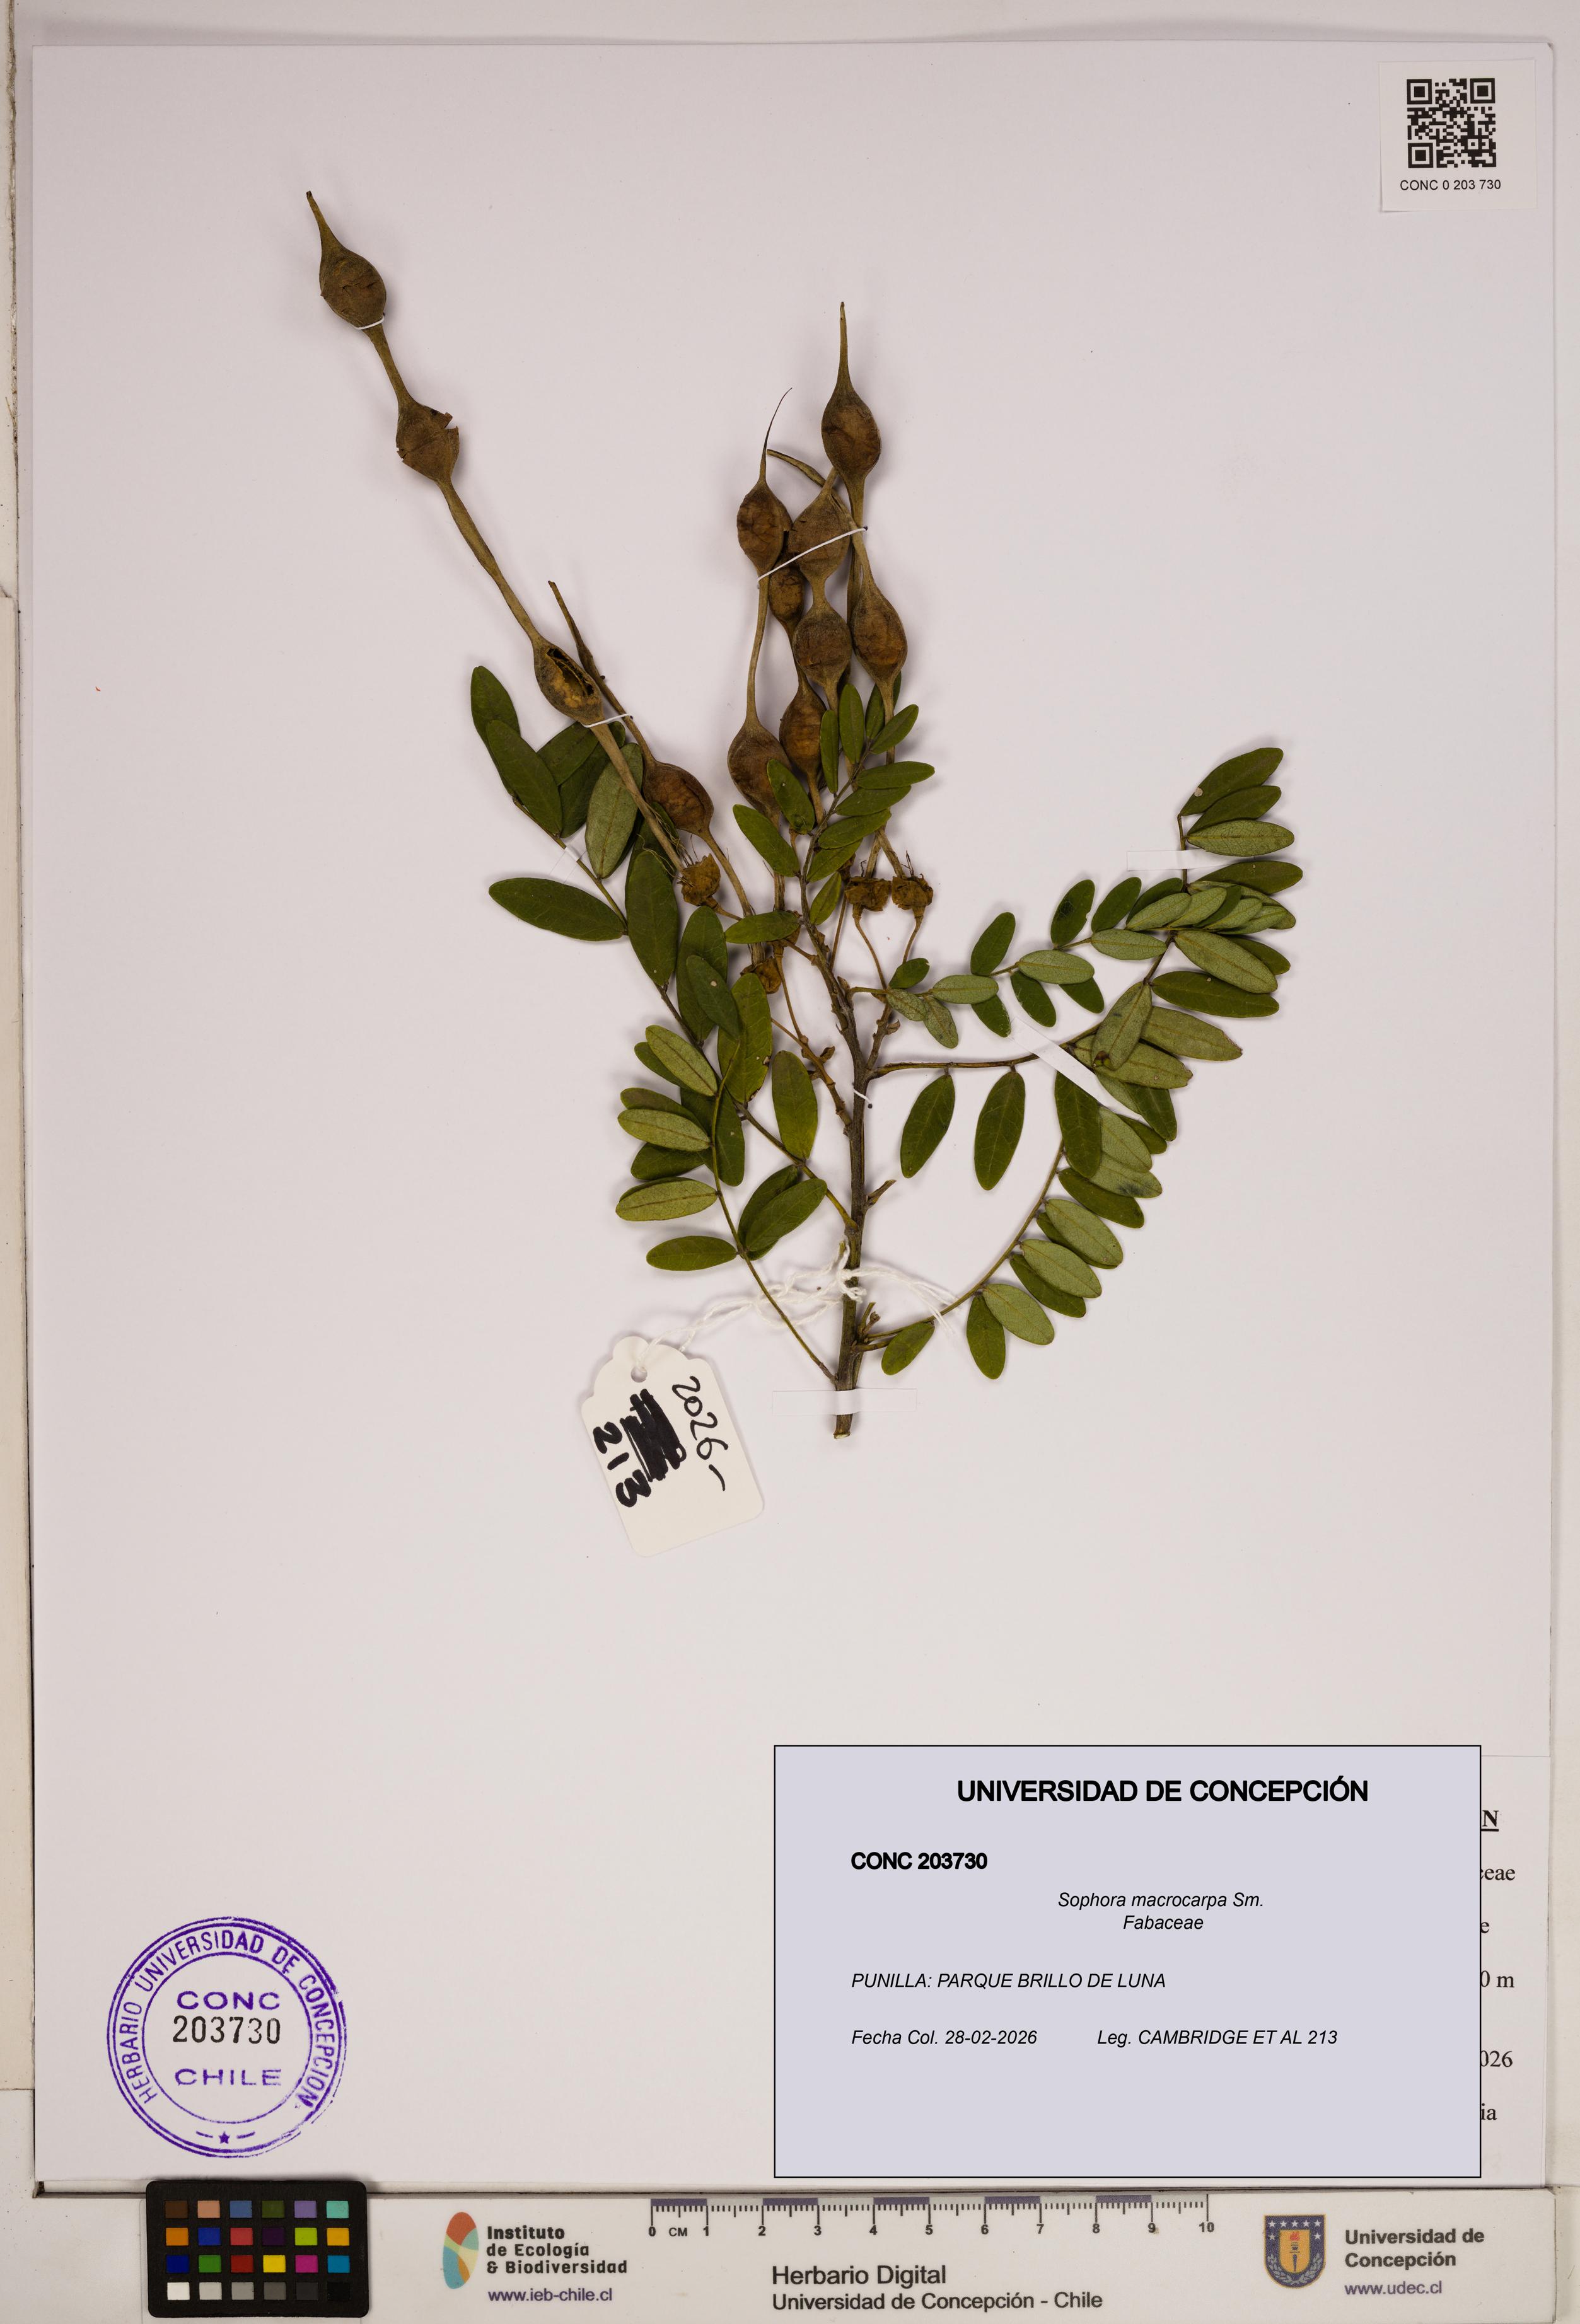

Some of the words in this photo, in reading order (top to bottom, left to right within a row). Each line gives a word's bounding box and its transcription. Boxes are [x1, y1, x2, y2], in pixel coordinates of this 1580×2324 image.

[1400, 180, 1439, 190] CONC
[1443, 180, 1449, 190] 0
[1453, 180, 1475, 190] 203
[1479, 180, 1501, 190] 730
[134, 1929, 265, 1992] UNIVERSIDAD
[271, 1945, 301, 1975] DE
[1496, 1975, 1515, 1988] m
[177, 1991, 280, 2010] CONC
[172, 2015, 281, 2044] 203730
[119, 2001, 158, 2104] HERBARIO
[174, 2068, 282, 2086] CHILE
[487, 2225, 565, 2240] Instituto
[649, 2226, 656, 2237] 0
[668, 2227, 688, 2237] CM
[703, 2226, 709, 2236] 1
[758, 2226, 766, 2236] 2
[814, 2225, 822, 2236] 3
[869, 2225, 878, 2236] 4
[926, 2225, 933, 2235] 5
[981, 2224, 989, 2234] 6
[1037, 2224, 1044, 2234] 7
[1093, 2223, 1100, 2234] 8
[1147, 2223, 1156, 2234] 9
[1199, 2222, 1215, 2233] 10
[1345, 2228, 1456, 2245] Universidad
[1461, 2228, 1485, 2244] de
[486, 2243, 507, 2257] de
[514, 2242, 589, 2259] Ecología
[487, 2260, 499, 2274] &
[505, 2260, 627, 2274] Biodiversidad
[1345, 2251, 1456, 2270] Concepción
[772, 2265, 869, 2285] Herbario
[877, 2265, 946, 2289] Digital
[487, 2287, 613, 2302] www.ieb-chile.cl
[1344, 2280, 1443, 2295] www.udec.cl
[773, 2292, 885, 2310] Universidad
[891, 2293, 915, 2310] de
[921, 2292, 1034, 2313] Concepción
[1054, 2291, 1103, 2308] Chile
